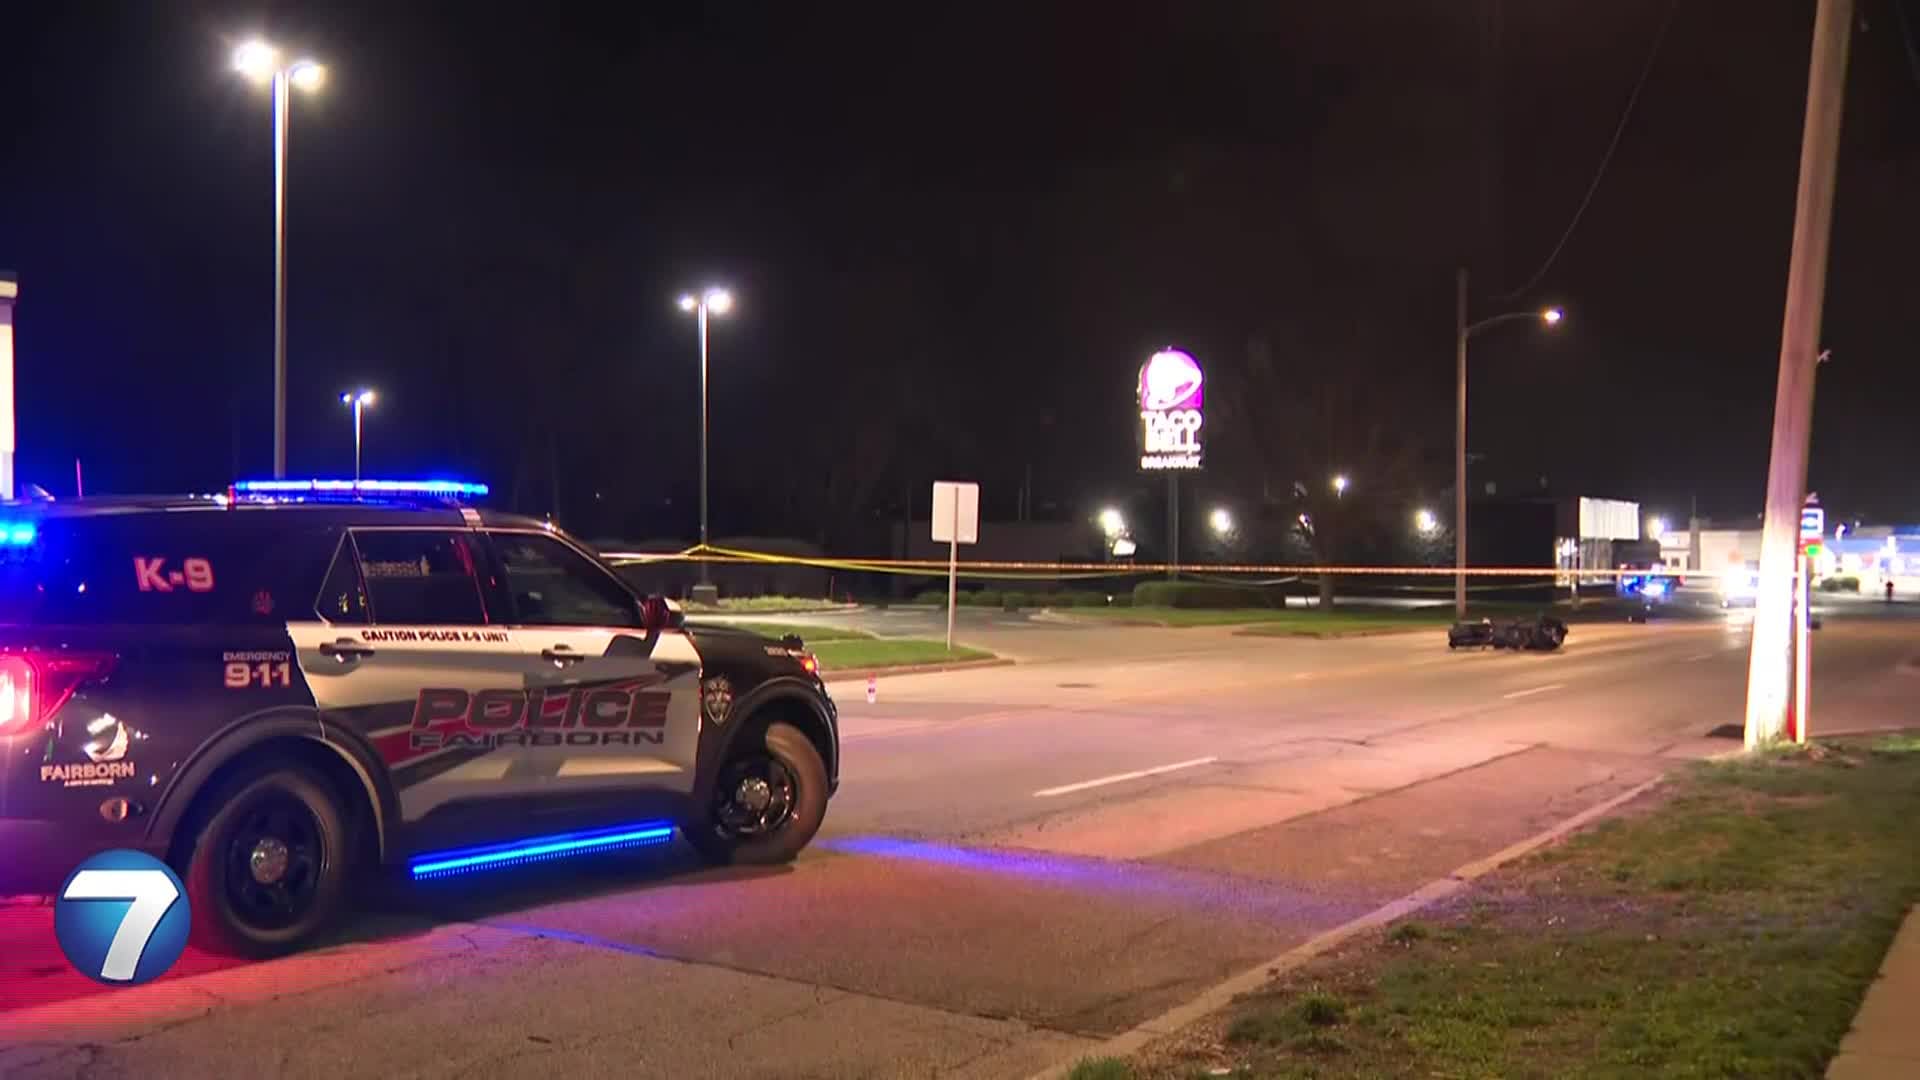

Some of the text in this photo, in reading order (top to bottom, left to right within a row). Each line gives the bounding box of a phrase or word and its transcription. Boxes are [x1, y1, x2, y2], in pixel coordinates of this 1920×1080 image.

[1141, 410, 1203, 431] TACO
[133, 556, 215, 592] K-9
[361, 630, 509, 643] CAUTION POLICE K-9 UNIT
[223, 652, 291, 662] EMERGENCY
[410, 686, 672, 729] POLICE
[409, 730, 665, 749] FAIRBORN
[41, 762, 135, 781] FAIRBORN
